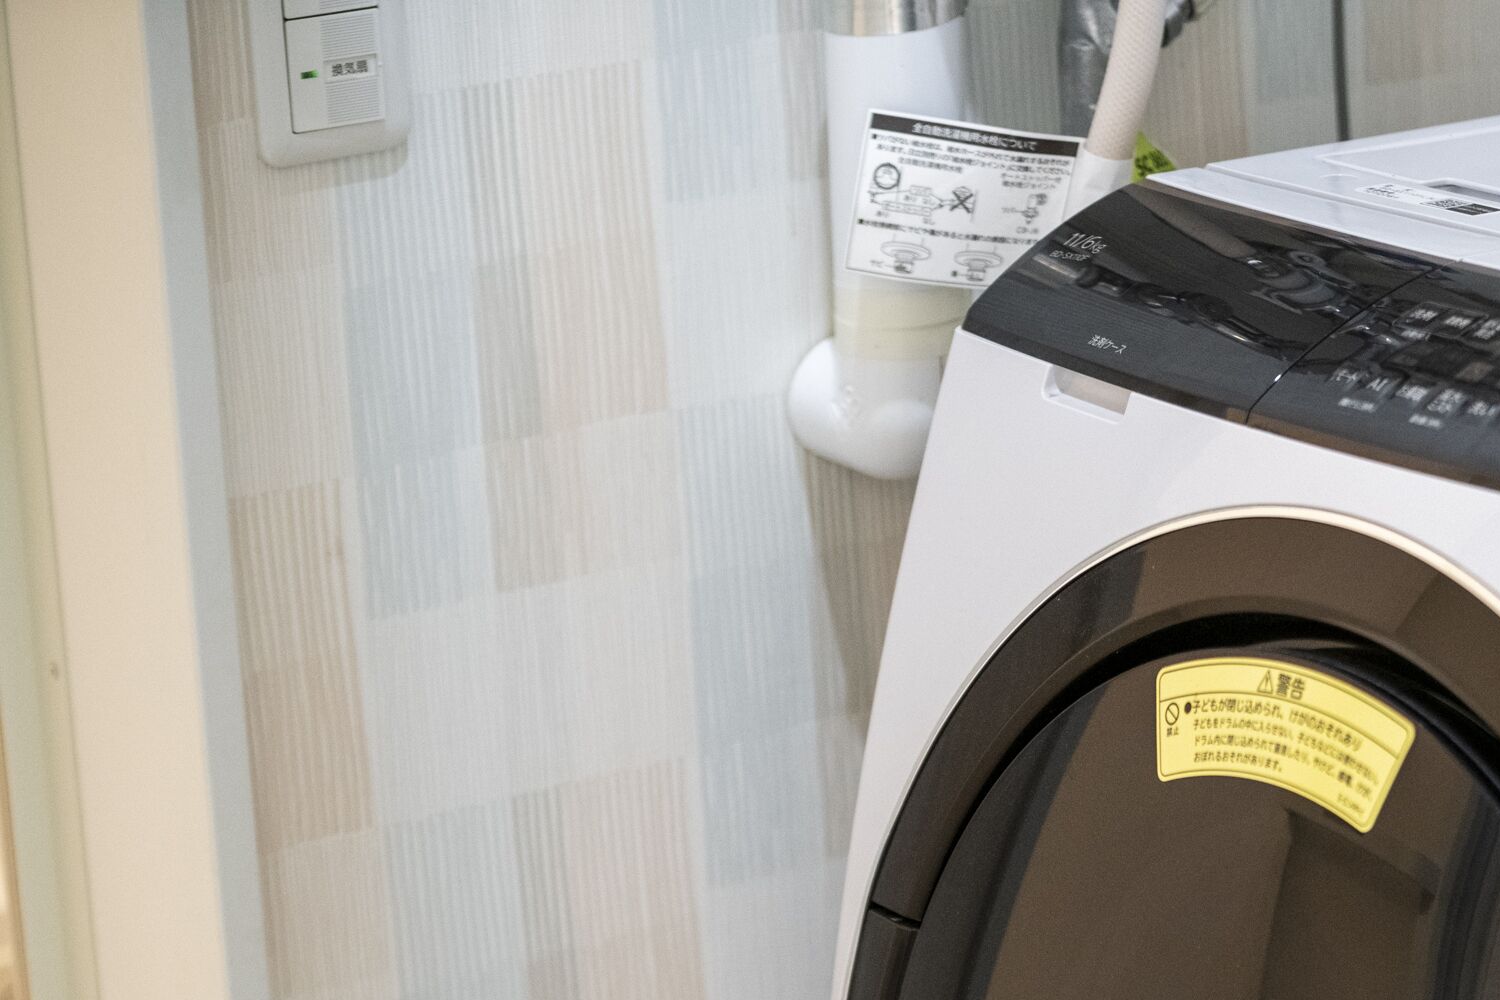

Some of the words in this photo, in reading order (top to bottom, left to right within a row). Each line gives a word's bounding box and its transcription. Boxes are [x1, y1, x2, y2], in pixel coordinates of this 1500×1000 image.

[1088, 334, 1127, 354] 洗剤ケース
[1275, 673, 1306, 701] 警告
[1167, 727, 1180, 737] 禁止
